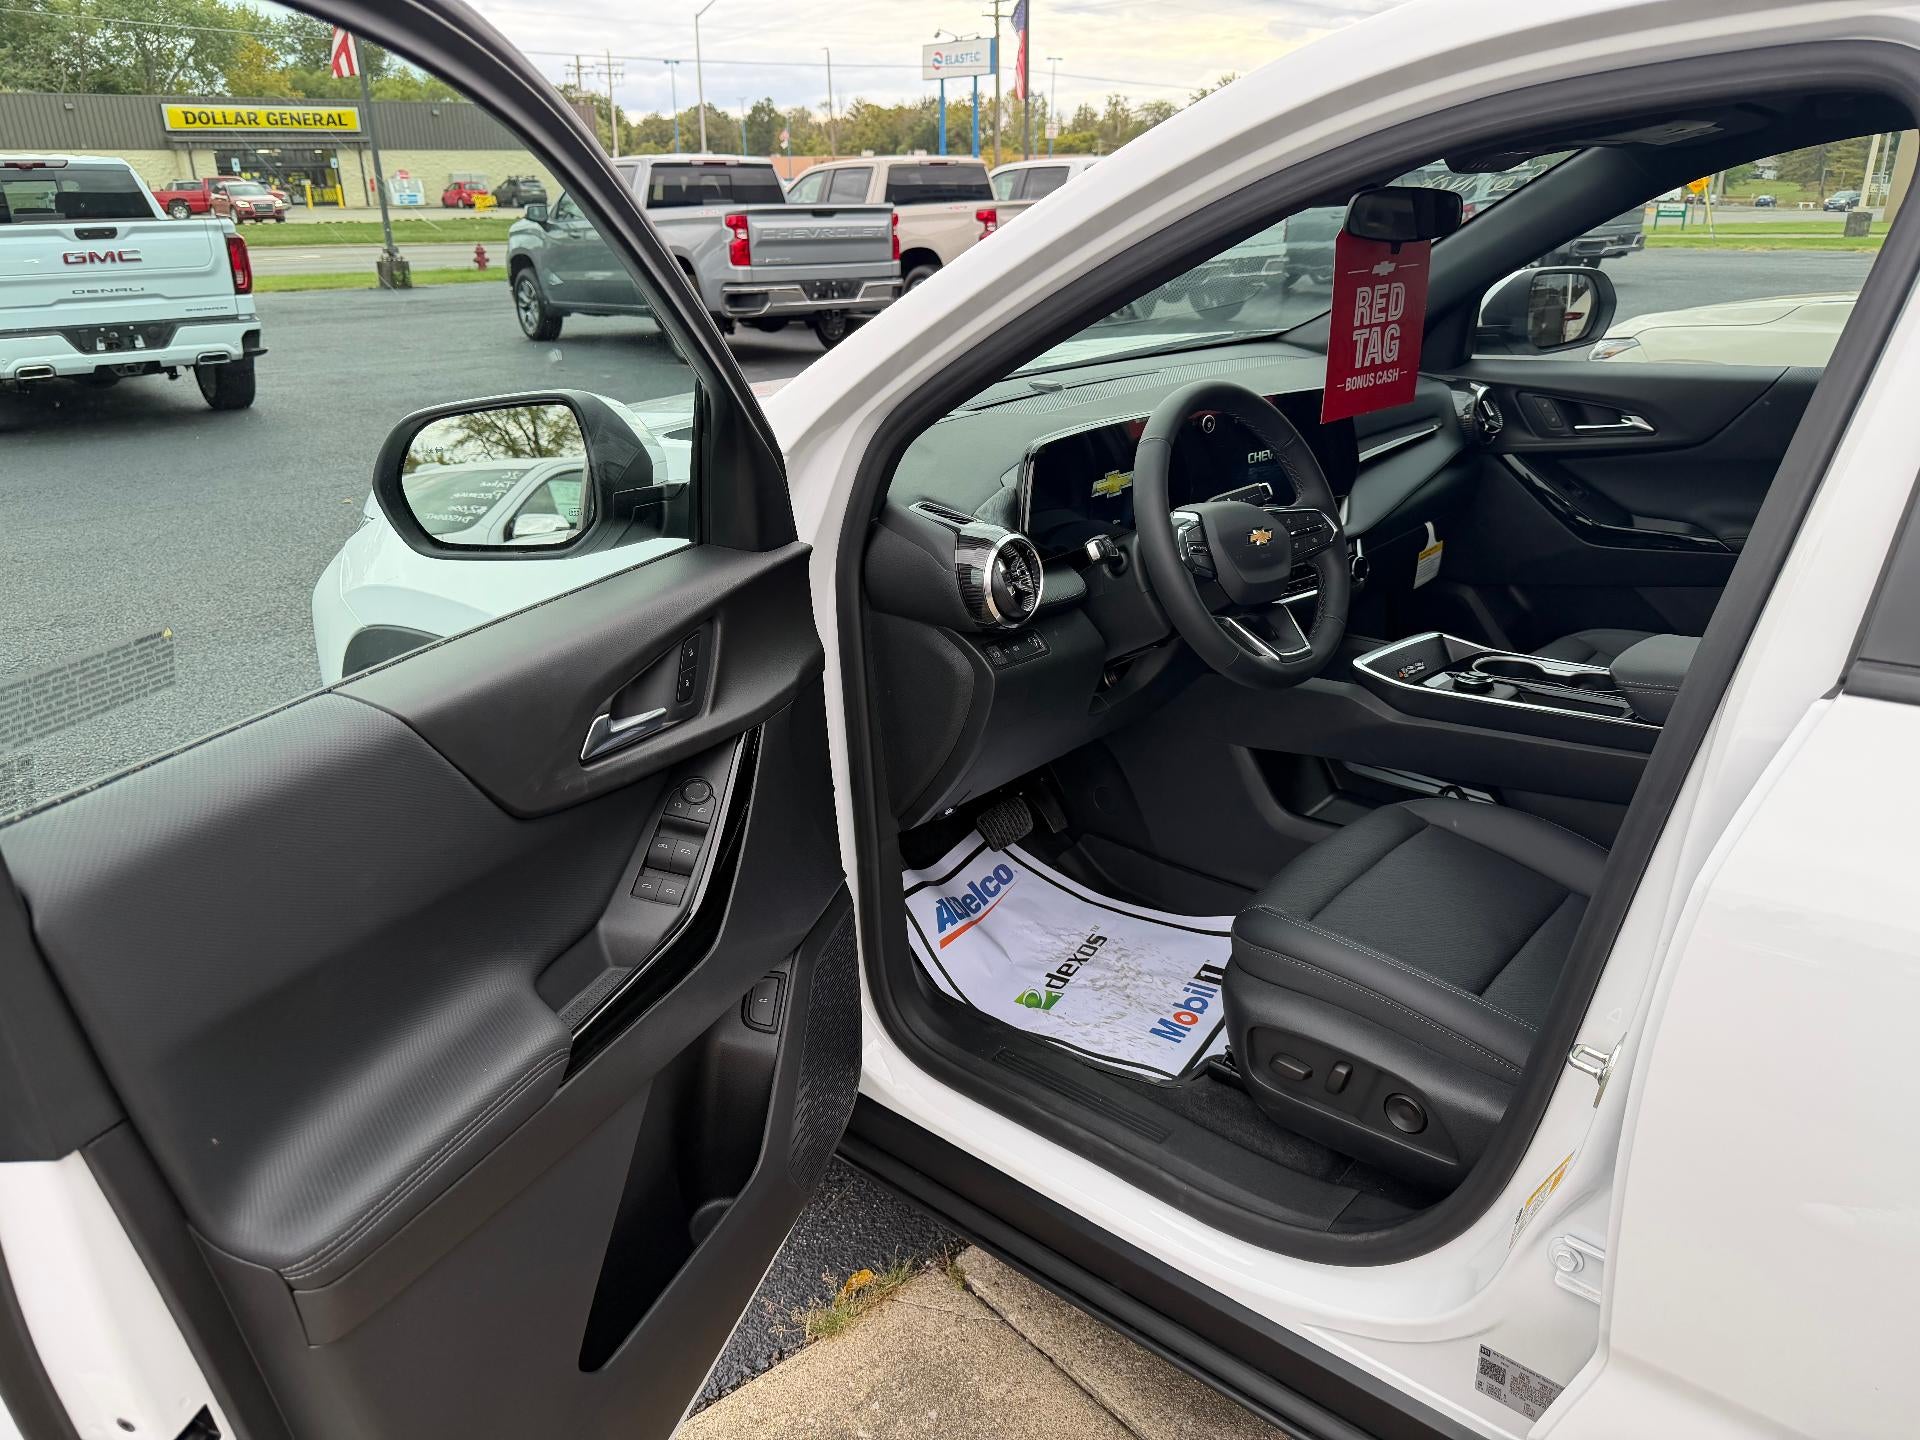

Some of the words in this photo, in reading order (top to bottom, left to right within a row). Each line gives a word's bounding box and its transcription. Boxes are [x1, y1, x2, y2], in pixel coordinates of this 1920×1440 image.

[945, 52, 981, 65] ELASTEC
[182, 110, 260, 126] DOLLAR
[266, 111, 348, 127] GENERAL
[761, 225, 885, 240] CHEVROLET
[62, 249, 142, 265] GMC
[72, 287, 144, 295] DENALI
[1353, 282, 1406, 327] RED
[1352, 323, 1401, 369] TAG
[1345, 373, 1375, 392] BONUS
[1376, 368, 1400, 385] CASH
[1247, 449, 1275, 464] CHEV
[1149, 981, 1219, 1044] Mobil
